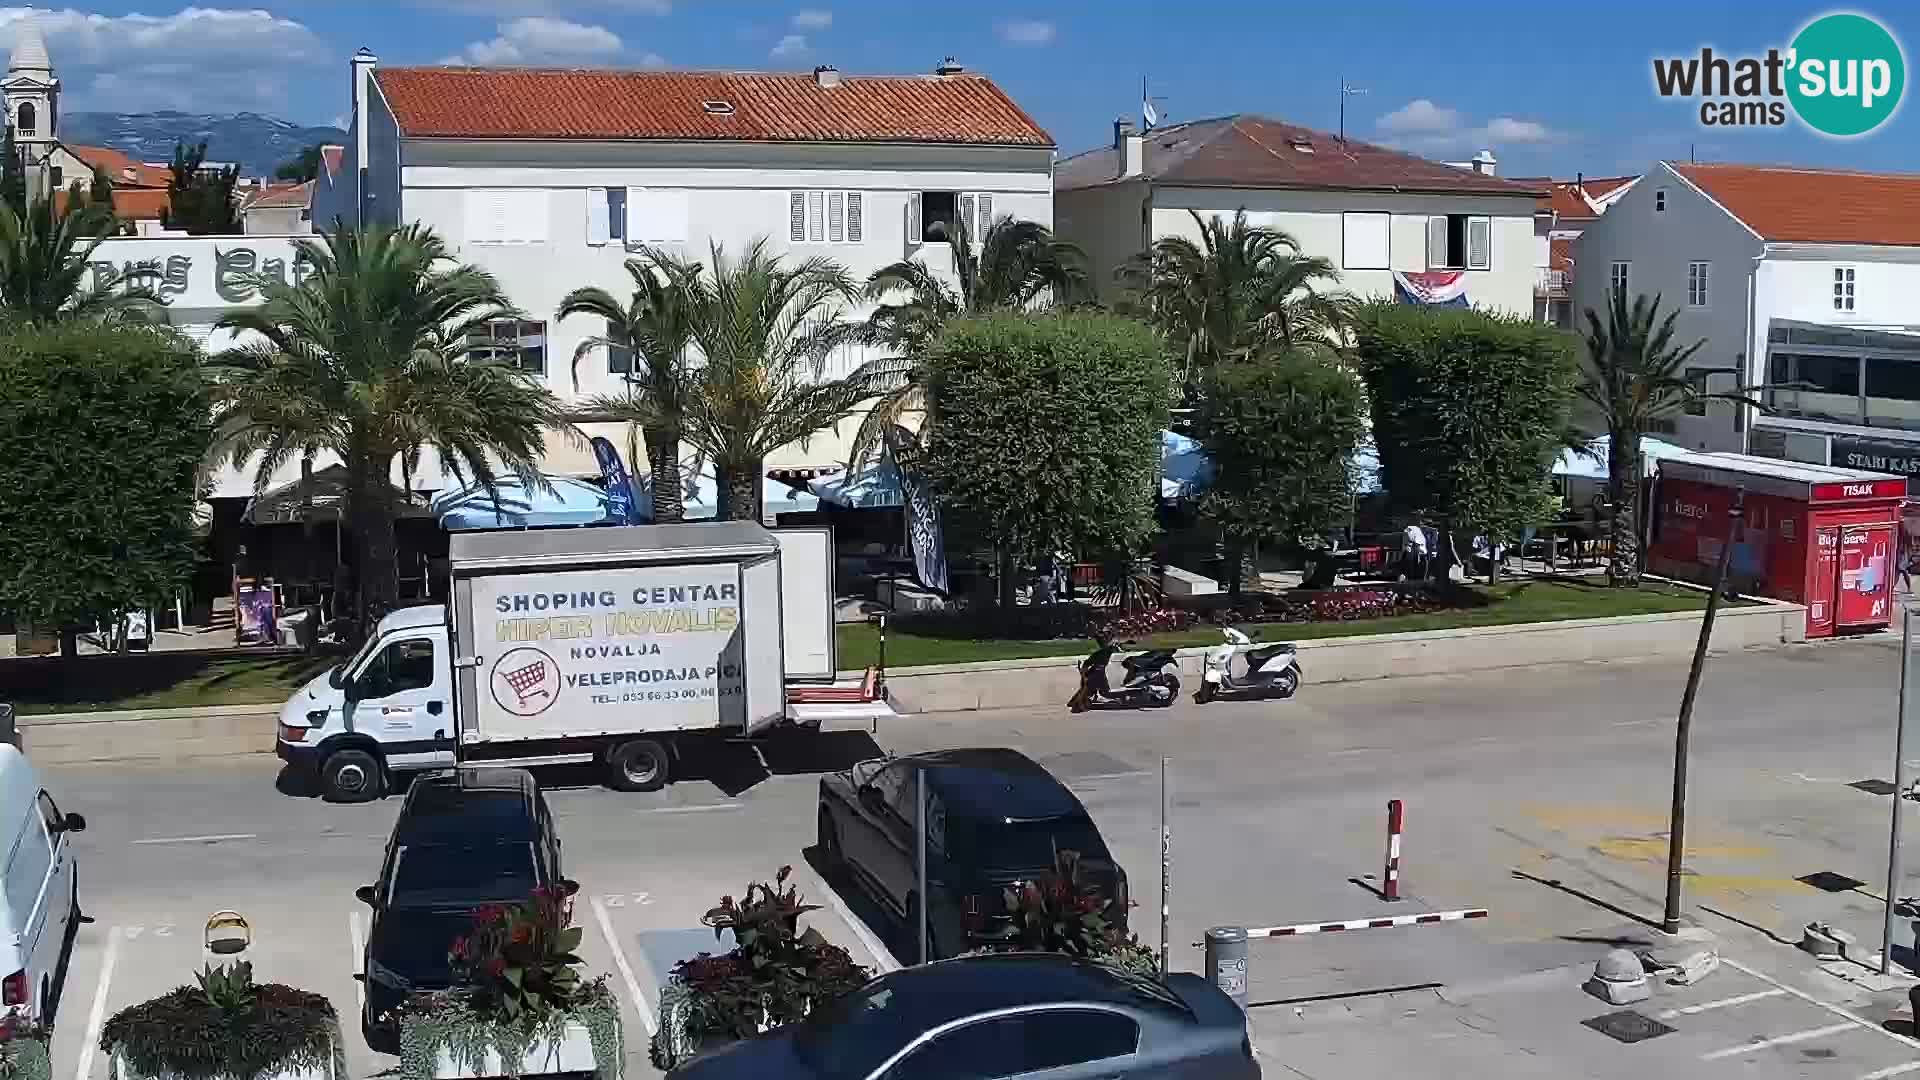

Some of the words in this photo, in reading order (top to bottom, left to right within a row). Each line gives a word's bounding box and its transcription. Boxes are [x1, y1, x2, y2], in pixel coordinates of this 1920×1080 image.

[1843, 484, 1873, 496] TISAK
[1818, 534, 1838, 548] Buy
[1843, 531, 1869, 546] here!
[496, 591, 616, 612] SHOPING
[632, 583, 737, 605] CENTAR
[496, 616, 593, 641] HIPER
[602, 607, 738, 637] NOVALIS
[570, 643, 661, 659] NOVALJA
[566, 667, 700, 688] VELEPRODAJA
